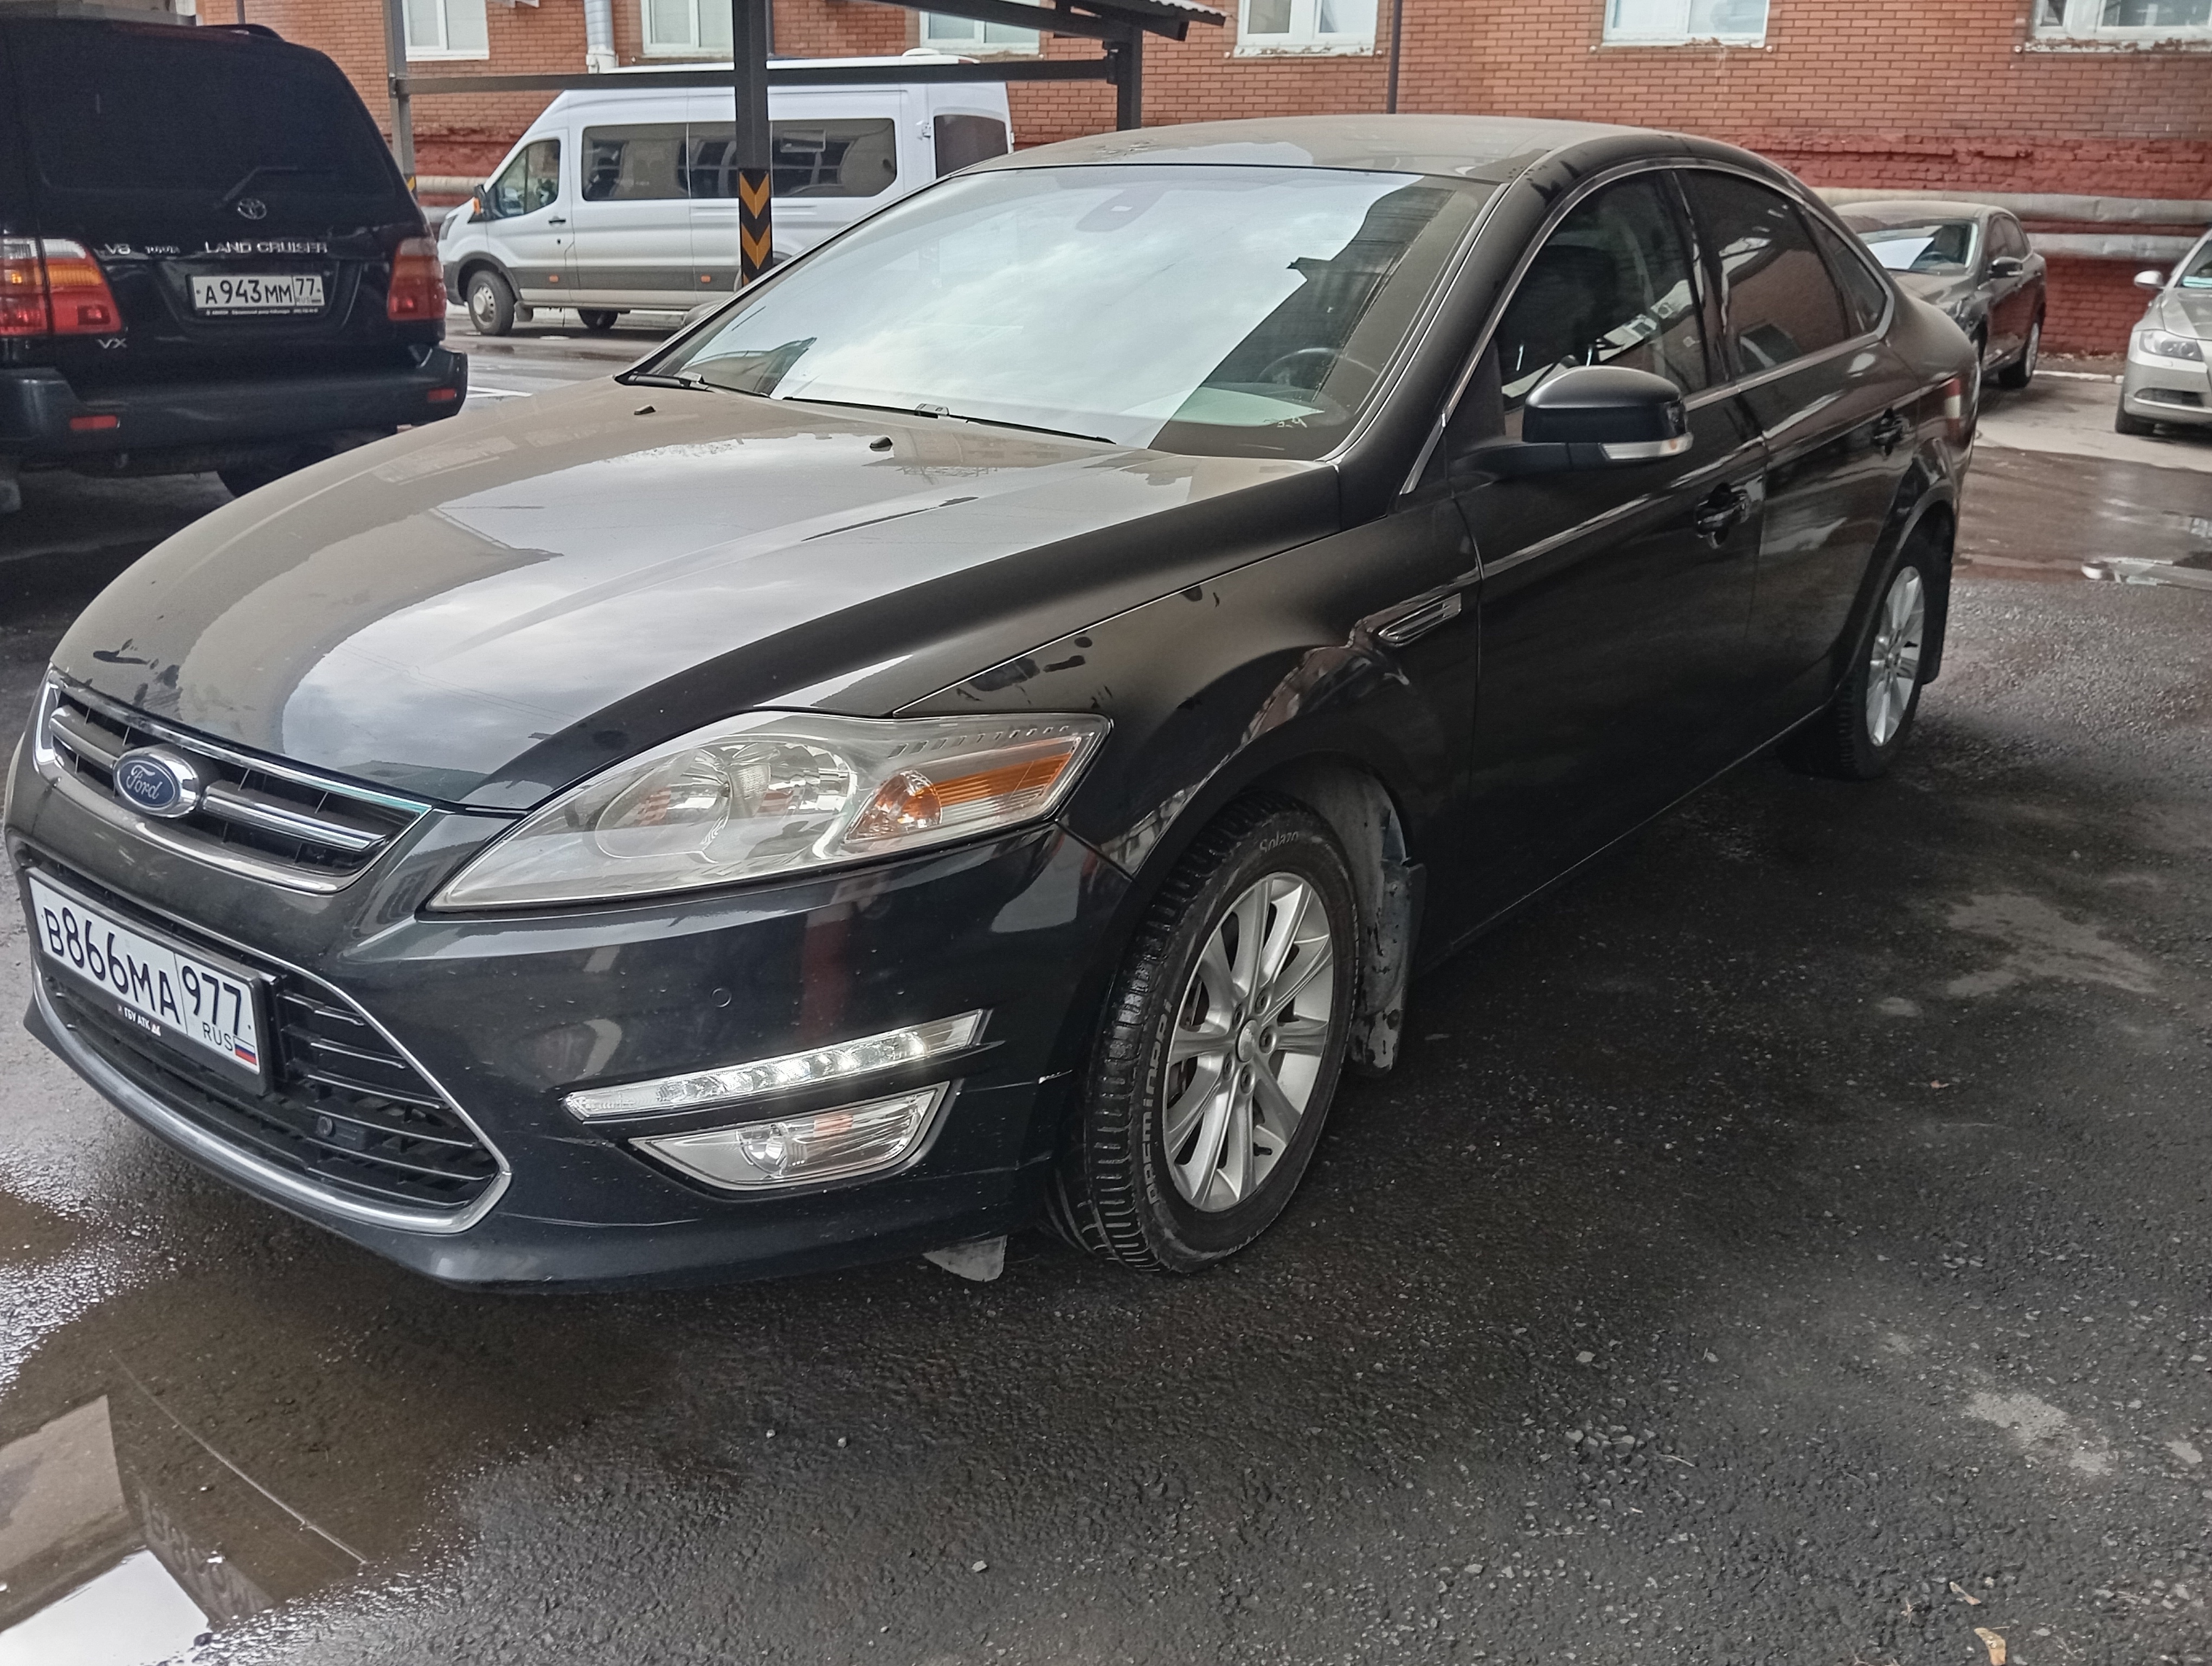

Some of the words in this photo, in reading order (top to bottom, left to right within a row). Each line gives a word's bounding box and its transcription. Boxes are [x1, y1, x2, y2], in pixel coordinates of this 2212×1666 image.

[105, 244, 131, 255] V8
[205, 241, 252, 253] LAND
[256, 241, 328, 253] CRUISER
[295, 278, 315, 296] 77
[98, 338, 127, 349] VX
[126, 764, 163, 800] Ford
[182, 965, 241, 1036] 977
[124, 1007, 136, 1022] ГБУ
[137, 1014, 151, 1030] АТК
[202, 1022, 233, 1052] RUS
